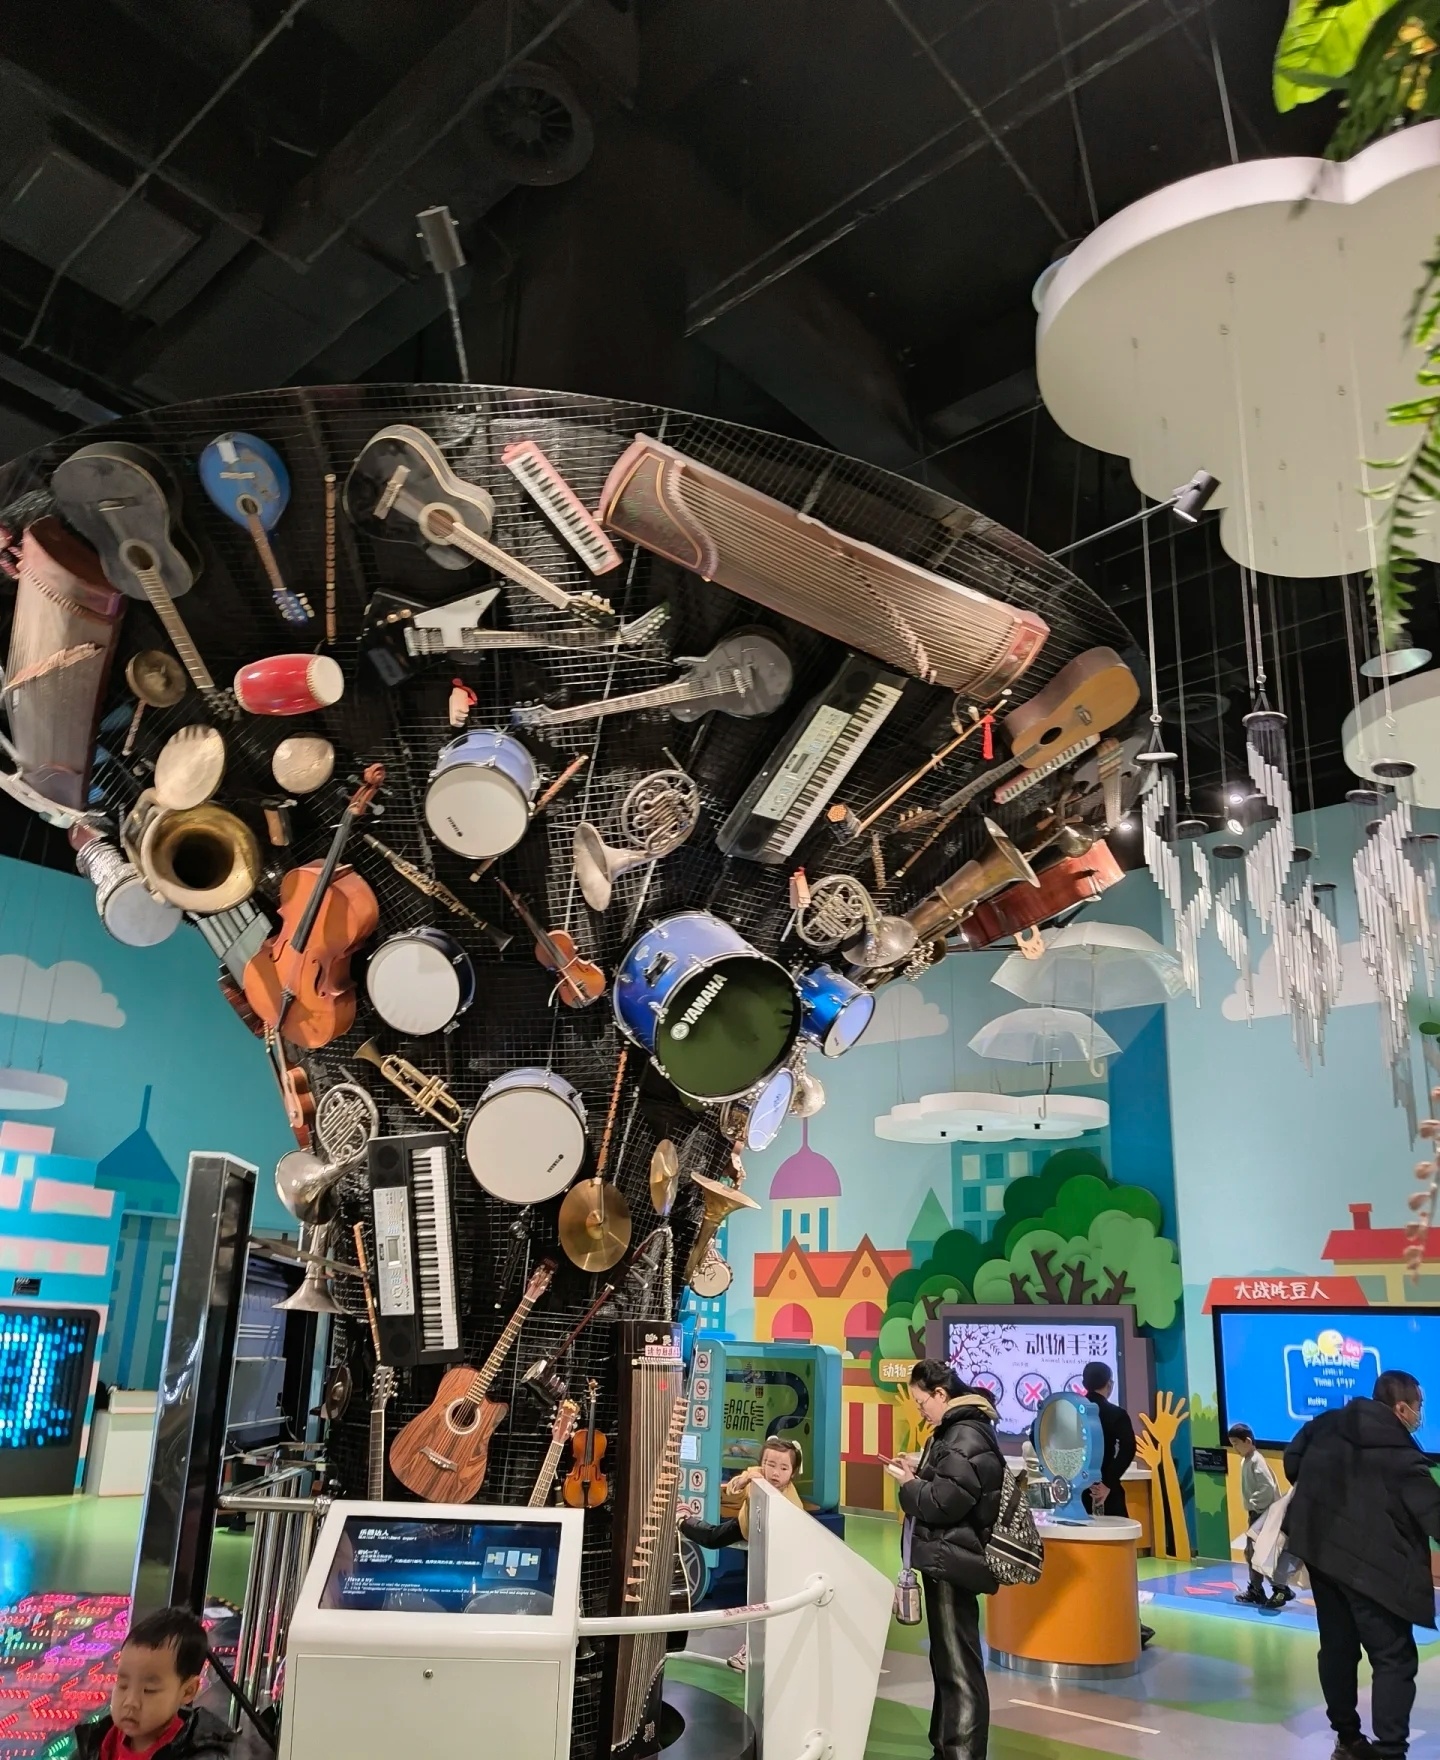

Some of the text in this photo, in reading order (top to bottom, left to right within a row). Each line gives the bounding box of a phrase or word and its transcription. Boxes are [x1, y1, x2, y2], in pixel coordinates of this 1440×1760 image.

[680, 973, 728, 1025] YAMAHA
[1234, 1281, 1330, 1300] 大战吃豆人
[1025, 1333, 1108, 1356] 动物手影
[1303, 1352, 1360, 1370] FAILURE
[728, 1398, 758, 1415] RACE
[726, 1414, 758, 1432] GAME
